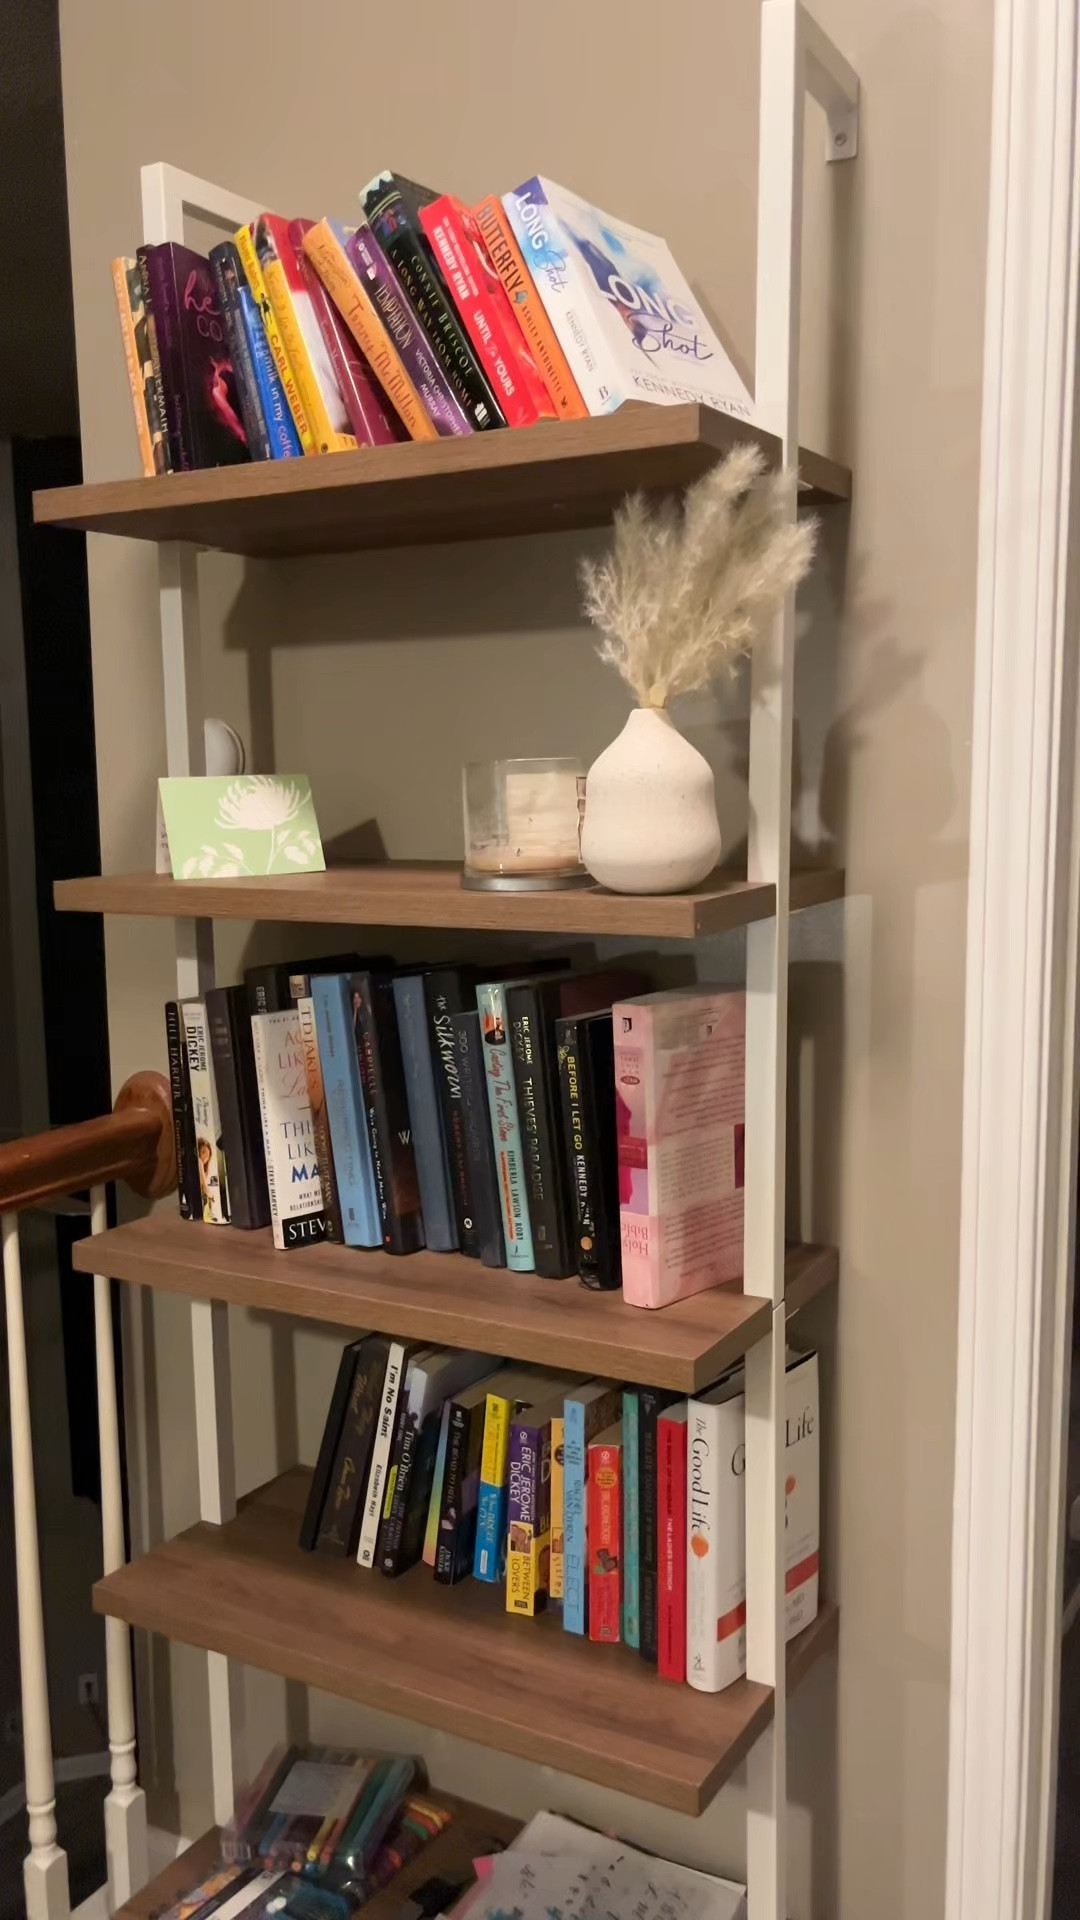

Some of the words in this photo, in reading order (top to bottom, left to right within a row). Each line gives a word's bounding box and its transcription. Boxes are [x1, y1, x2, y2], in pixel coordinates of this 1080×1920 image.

[511, 190, 550, 251] LONG
[431, 224, 459, 271] KENNEDY
[449, 269, 471, 301] RYAN
[472, 201, 523, 292] BUTTERFLY
[407, 254, 441, 308] CONNIE
[531, 245, 574, 298] Shot
[369, 280, 420, 350] TEMPTATION
[395, 260, 419, 296] LONG
[413, 297, 435, 328] WAY
[429, 329, 454, 368] FROM
[519, 304, 539, 339] ASHLEY
[471, 309, 493, 345] UNTIL
[490, 354, 516, 398] YOURS
[564, 309, 586, 348] KENNEDY
[579, 347, 597, 374] RYAN
[627, 312, 714, 361] Shot
[268, 333, 289, 373] CARL
[282, 377, 309, 435] WEBER
[412, 347, 438, 385] VICTORIA
[269, 385, 282, 400] in
[418, 382, 442, 419] MURRAY
[632, 375, 704, 404] KENNEDY
[269, 401, 287, 423] my
[166, 1010, 180, 1042] HILL
[196, 1024, 205, 1043] ERIC
[457, 1029, 469, 1053] 300
[512, 1020, 525, 1063] DICKEY
[520, 1015, 530, 1033] ERIC
[185, 1025, 201, 1073] DICKEY
[198, 1043, 208, 1072] JEROME
[303, 1037, 320, 1089] JAKES
[522, 1035, 534, 1065] JEROME
[168, 1045, 184, 1100] HARPER
[566, 1055, 579, 1099] BEFORE
[520, 1075, 538, 1136] THIEVES'
[571, 1110, 581, 1130] LET
[573, 1132, 583, 1151] GO
[266, 1163, 276, 1187] STEVE
[505, 1148, 519, 1185] KIMBERLA
[526, 1137, 545, 1202] PARADISE
[574, 1153, 588, 1197] KENNEDY
[268, 1187, 279, 1218] HARVEY
[324, 1181, 332, 1202] MAN
[509, 1187, 522, 1219] LAWSON
[513, 1220, 524, 1242] ROBY
[622, 1222, 649, 1241] Bible
[623, 1238, 649, 1257] Holy
[386, 1363, 399, 1386] I'm
[384, 1386, 395, 1404] No
[379, 1405, 393, 1439] Saint
[401, 1430, 414, 1451] Tim
[694, 1415, 707, 1436] The
[785, 1407, 815, 1448] Life
[394, 1451, 413, 1492] O'Brien
[520, 1445, 531, 1474] ERIC
[689, 1436, 710, 1494] Good
[509, 1460, 521, 1503] DICKEY
[519, 1474, 531, 1521] JEROME
[511, 1557, 522, 1594] LOVERS
[521, 1555, 531, 1600] BETWEEN
[564, 1553, 580, 1613] ELECT
